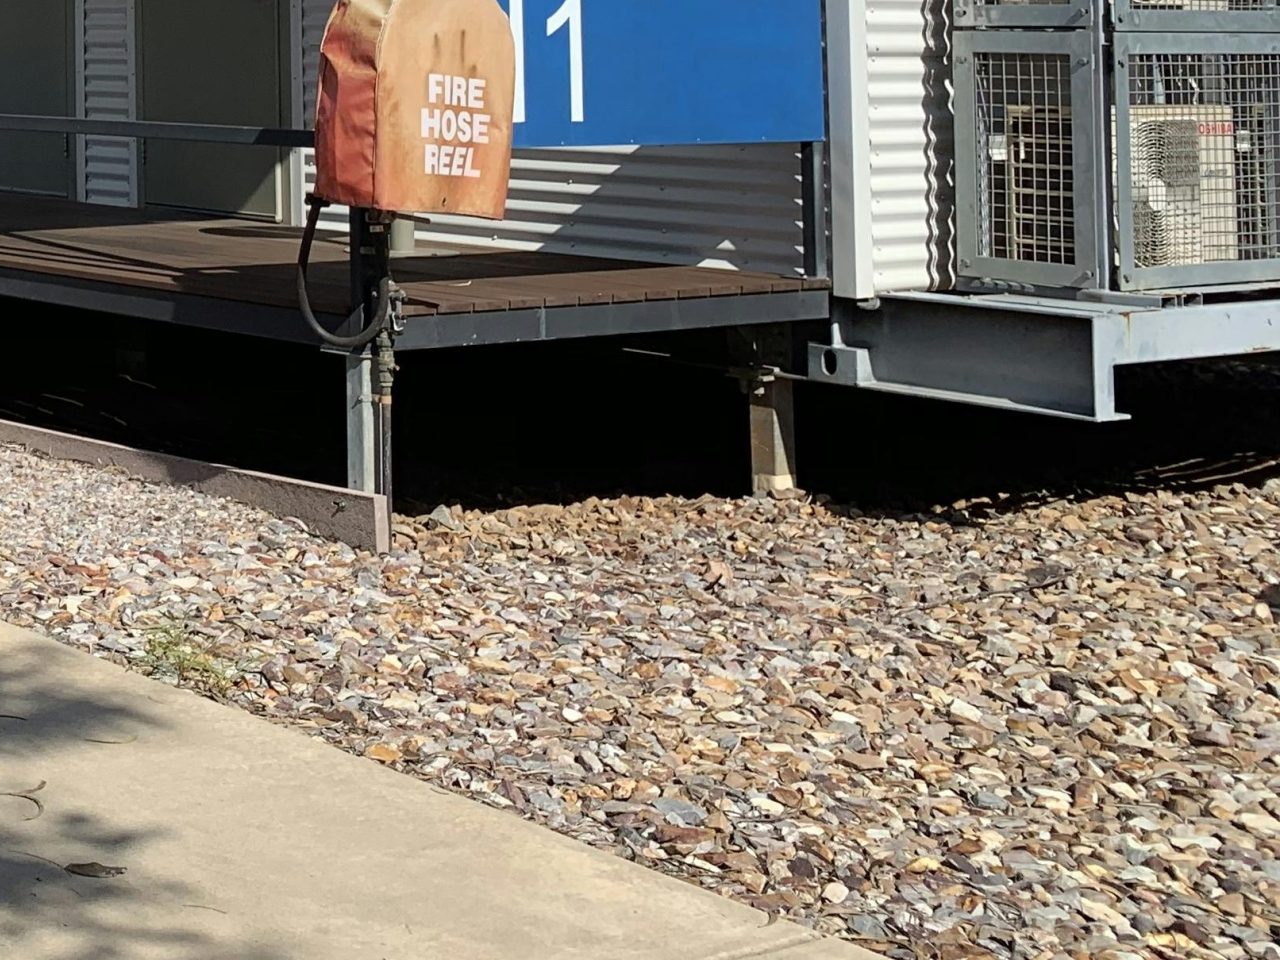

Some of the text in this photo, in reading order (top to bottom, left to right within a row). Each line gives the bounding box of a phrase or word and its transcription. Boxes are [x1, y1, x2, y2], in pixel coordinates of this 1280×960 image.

[428, 73, 486, 109] FIRE
[421, 107, 491, 144] HOSE
[1198, 123, 1233, 134] OSHIBA
[424, 143, 481, 178] REEL
